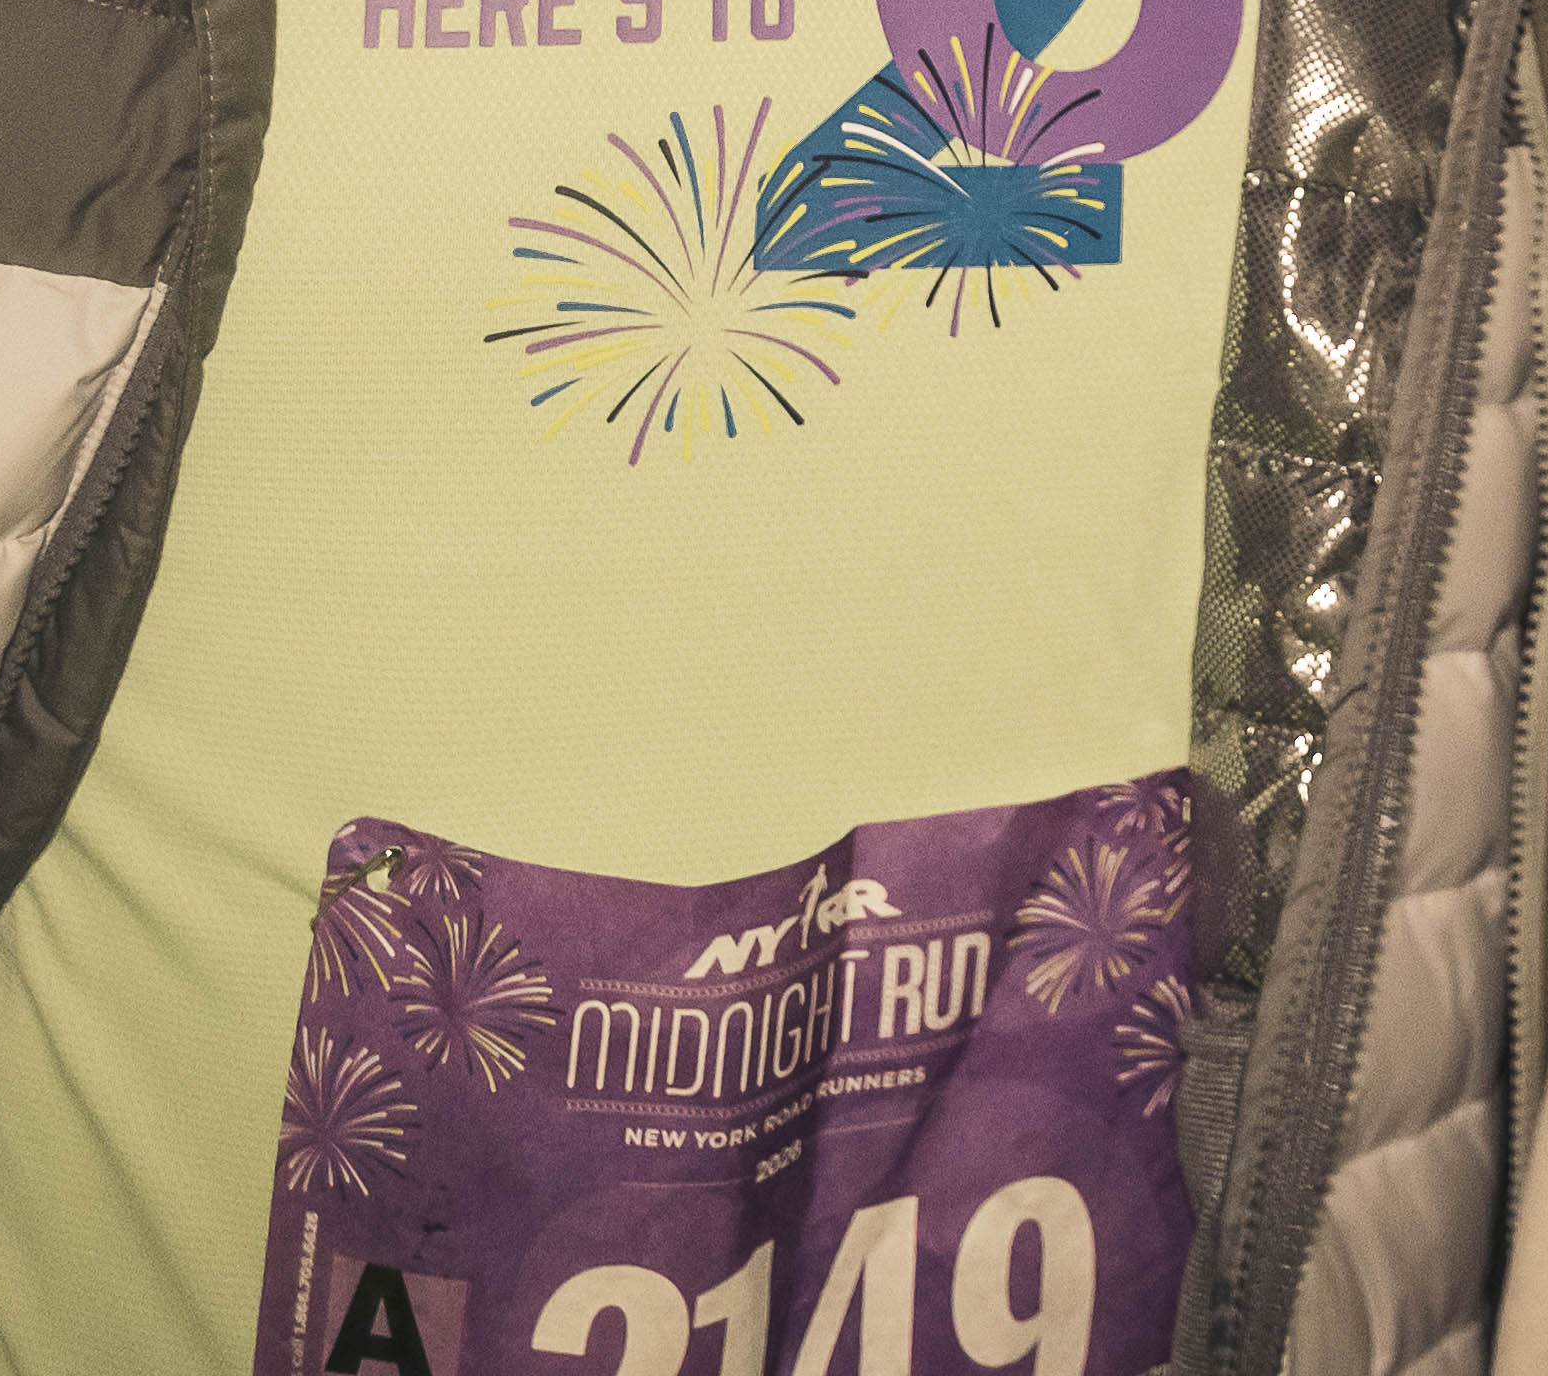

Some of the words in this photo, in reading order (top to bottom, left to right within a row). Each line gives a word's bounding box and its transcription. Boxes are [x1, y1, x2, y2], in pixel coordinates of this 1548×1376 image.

[566, 949, 871, 1098] MIDNIGHT
[877, 931, 992, 1039] RUN
[624, 1127, 691, 1149] NEW
[694, 1123, 758, 1149] YORK
[815, 1065, 927, 1101] RUNNERS
[324, 1261, 436, 1376] A
